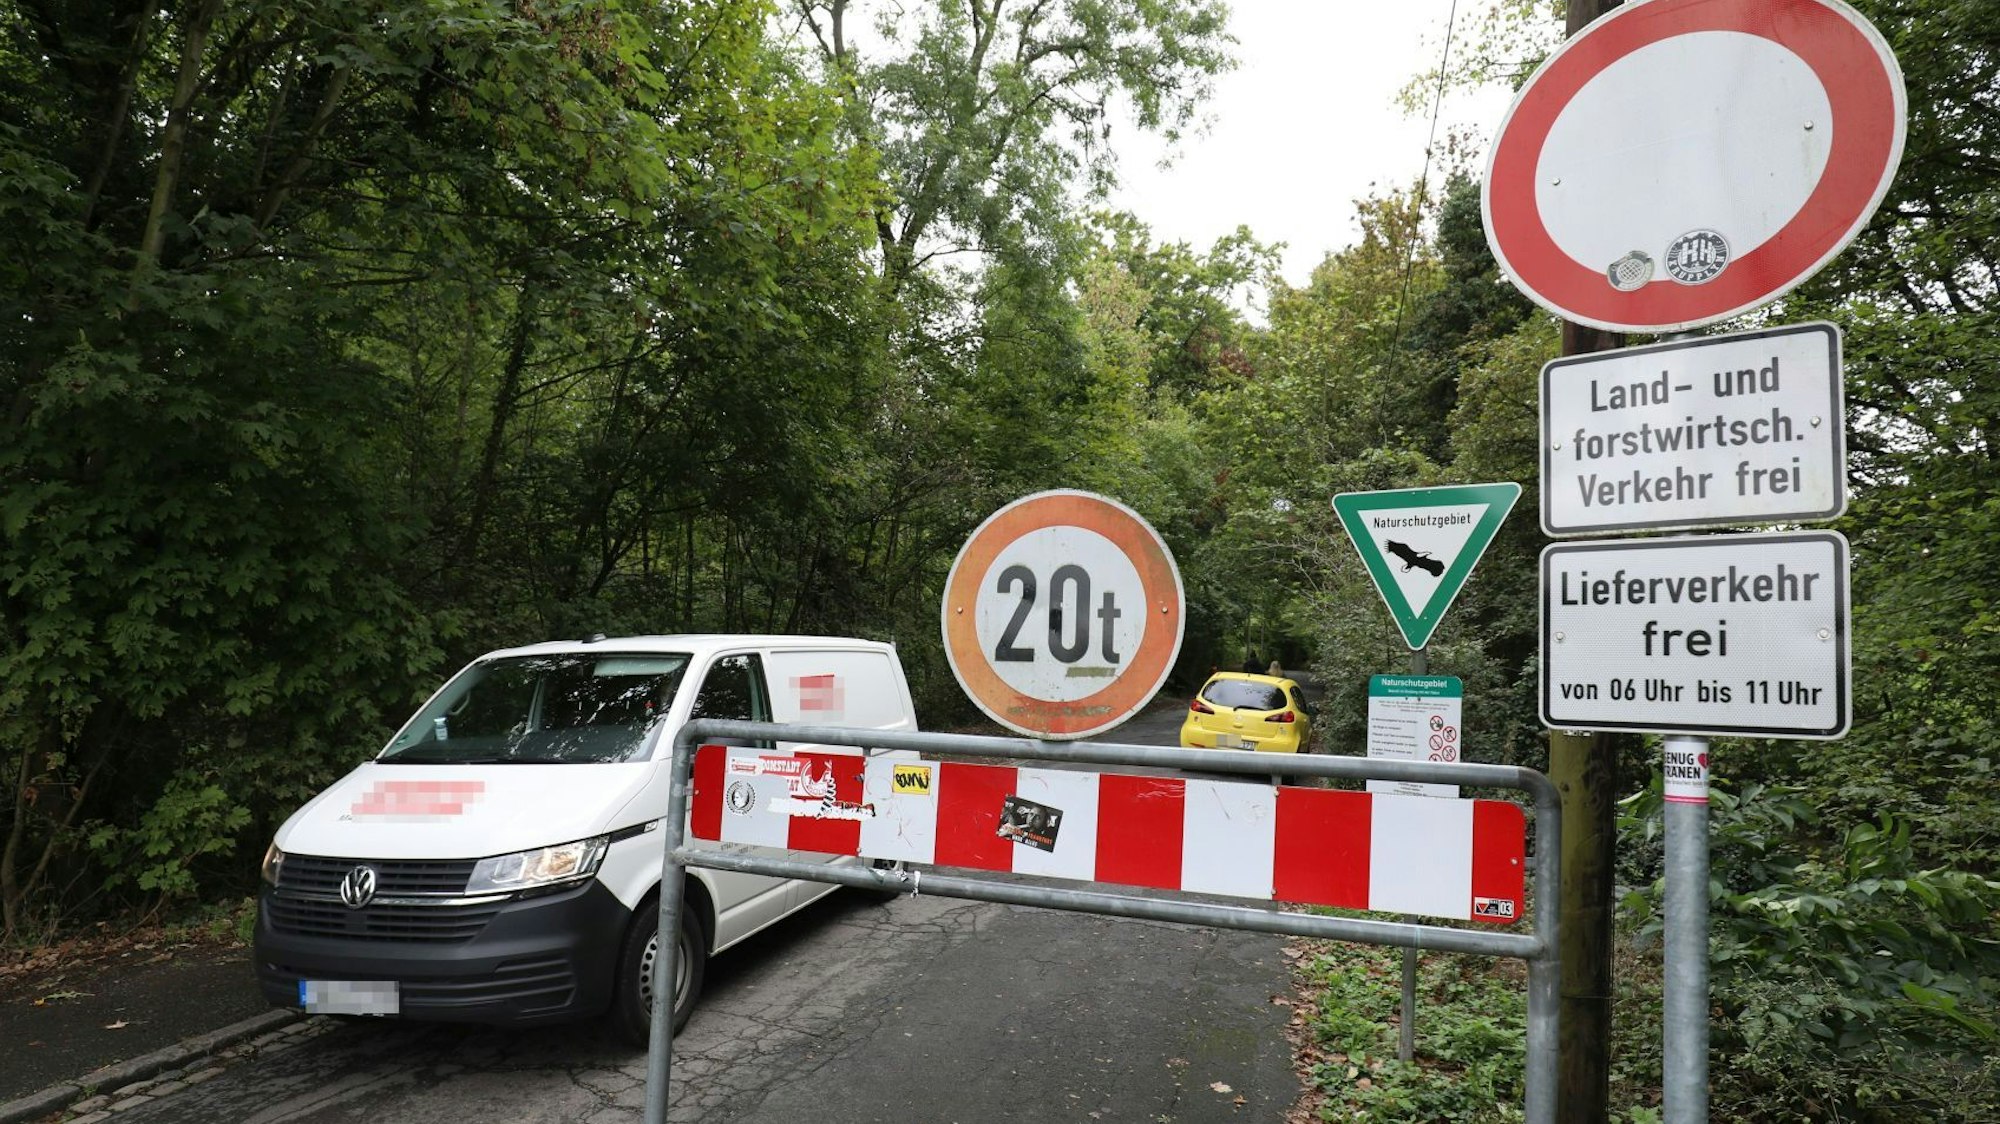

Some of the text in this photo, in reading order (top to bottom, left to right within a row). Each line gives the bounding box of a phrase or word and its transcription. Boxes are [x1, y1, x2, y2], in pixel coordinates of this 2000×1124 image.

[1590, 357, 1779, 412] Land- und
[1573, 407, 1804, 461] forstwirtsch.
[1577, 457, 1800, 507] Verkehr frei
[1373, 512, 1472, 529] Naturschutzgebiet
[1561, 564, 1820, 605] Lieferverkehr
[1643, 620, 1727, 656] frei
[1381, 678, 1448, 689] Naturschutzgebiet
[1561, 678, 1822, 705] von 06 Uhr bis 11 Uhr
[1664, 752, 1694, 765] ENUG
[1500, 902, 1512, 915] 03
